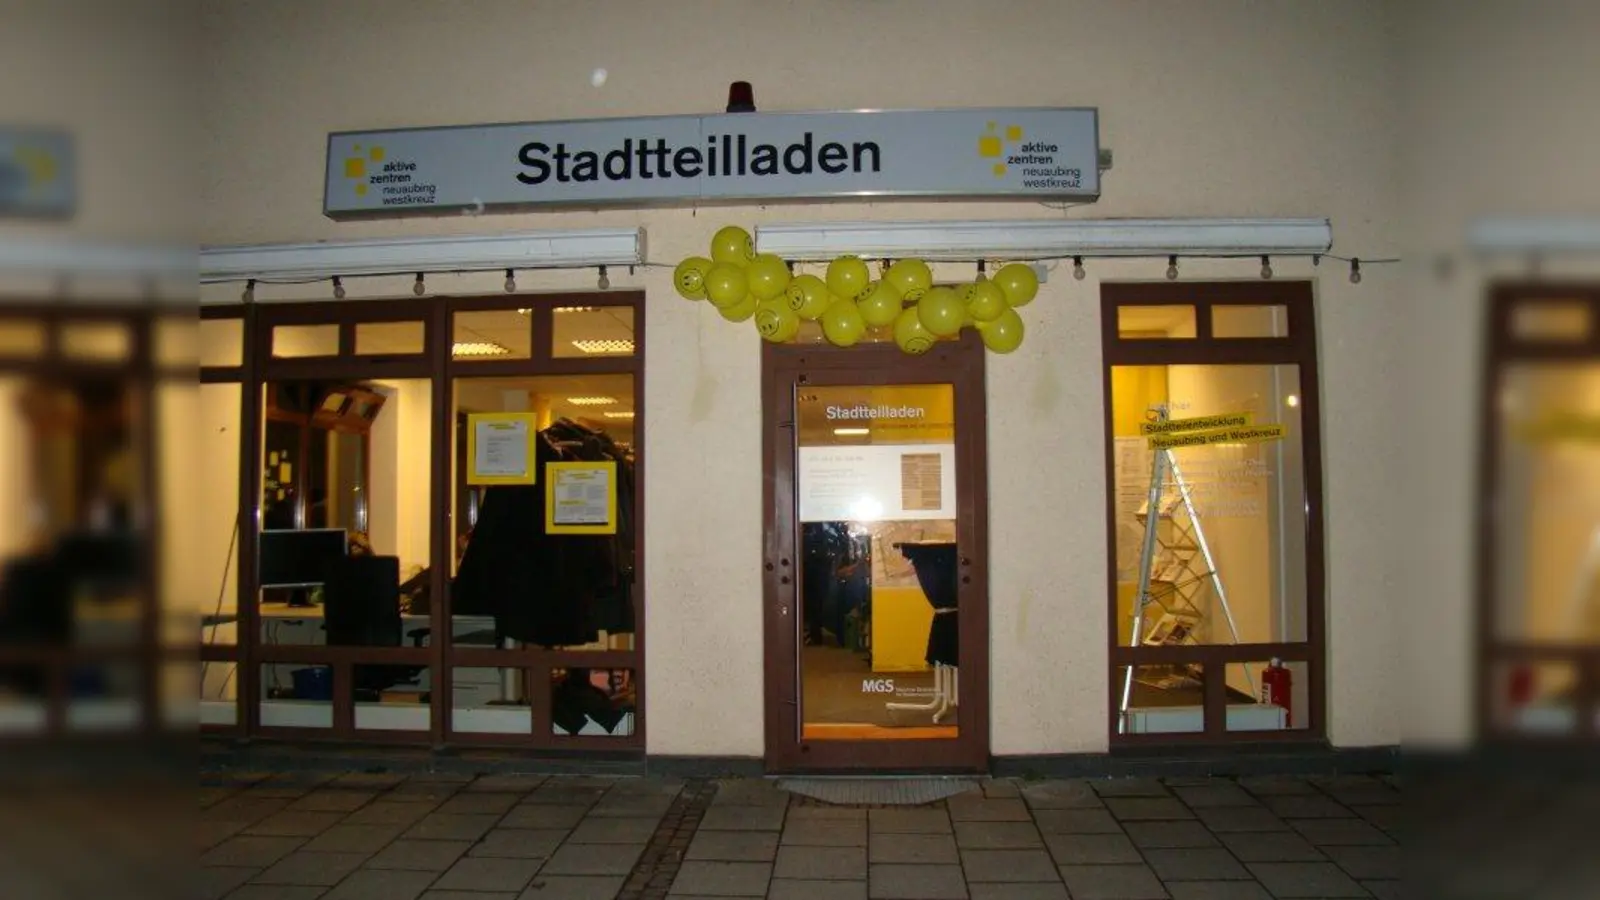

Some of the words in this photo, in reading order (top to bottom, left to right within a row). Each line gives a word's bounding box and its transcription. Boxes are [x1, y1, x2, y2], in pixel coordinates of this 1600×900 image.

[1021, 142, 1058, 153] aktive
[515, 131, 880, 185] Stadtteilladen
[1007, 155, 1053, 165] zentren
[383, 161, 417, 173] aktive
[1023, 166, 1081, 179] neuaubing
[370, 174, 411, 184] zentren
[1023, 178, 1081, 188] westkreuz
[382, 184, 436, 195] neuaubing
[382, 195, 435, 205] westkreuz
[826, 405, 925, 419] Stadtteilladen
[1144, 415, 1246, 434] Stadtteilentwicklung
[1152, 435, 1206, 448] Neuaubing
[1209, 433, 1227, 443] und
[1231, 428, 1281, 440] Westkreuz
[862, 679, 894, 693] MGS
